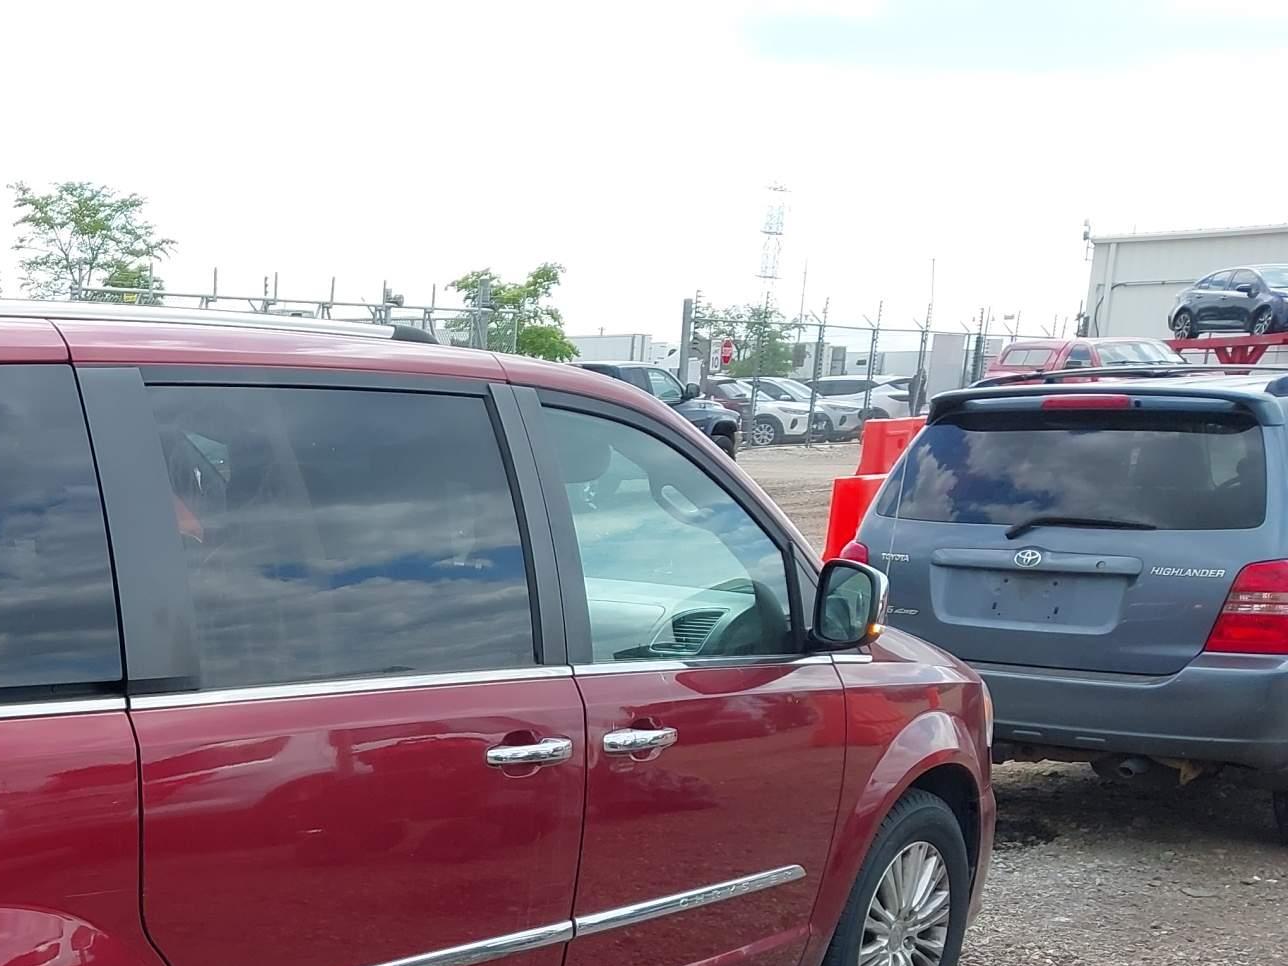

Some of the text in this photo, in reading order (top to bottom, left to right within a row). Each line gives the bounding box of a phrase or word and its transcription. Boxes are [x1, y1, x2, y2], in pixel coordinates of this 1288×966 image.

[881, 552, 910, 562] TOYOTA
[1150, 566, 1226, 578] HIGHLANDER
[679, 870, 793, 908] CHRYSLER
